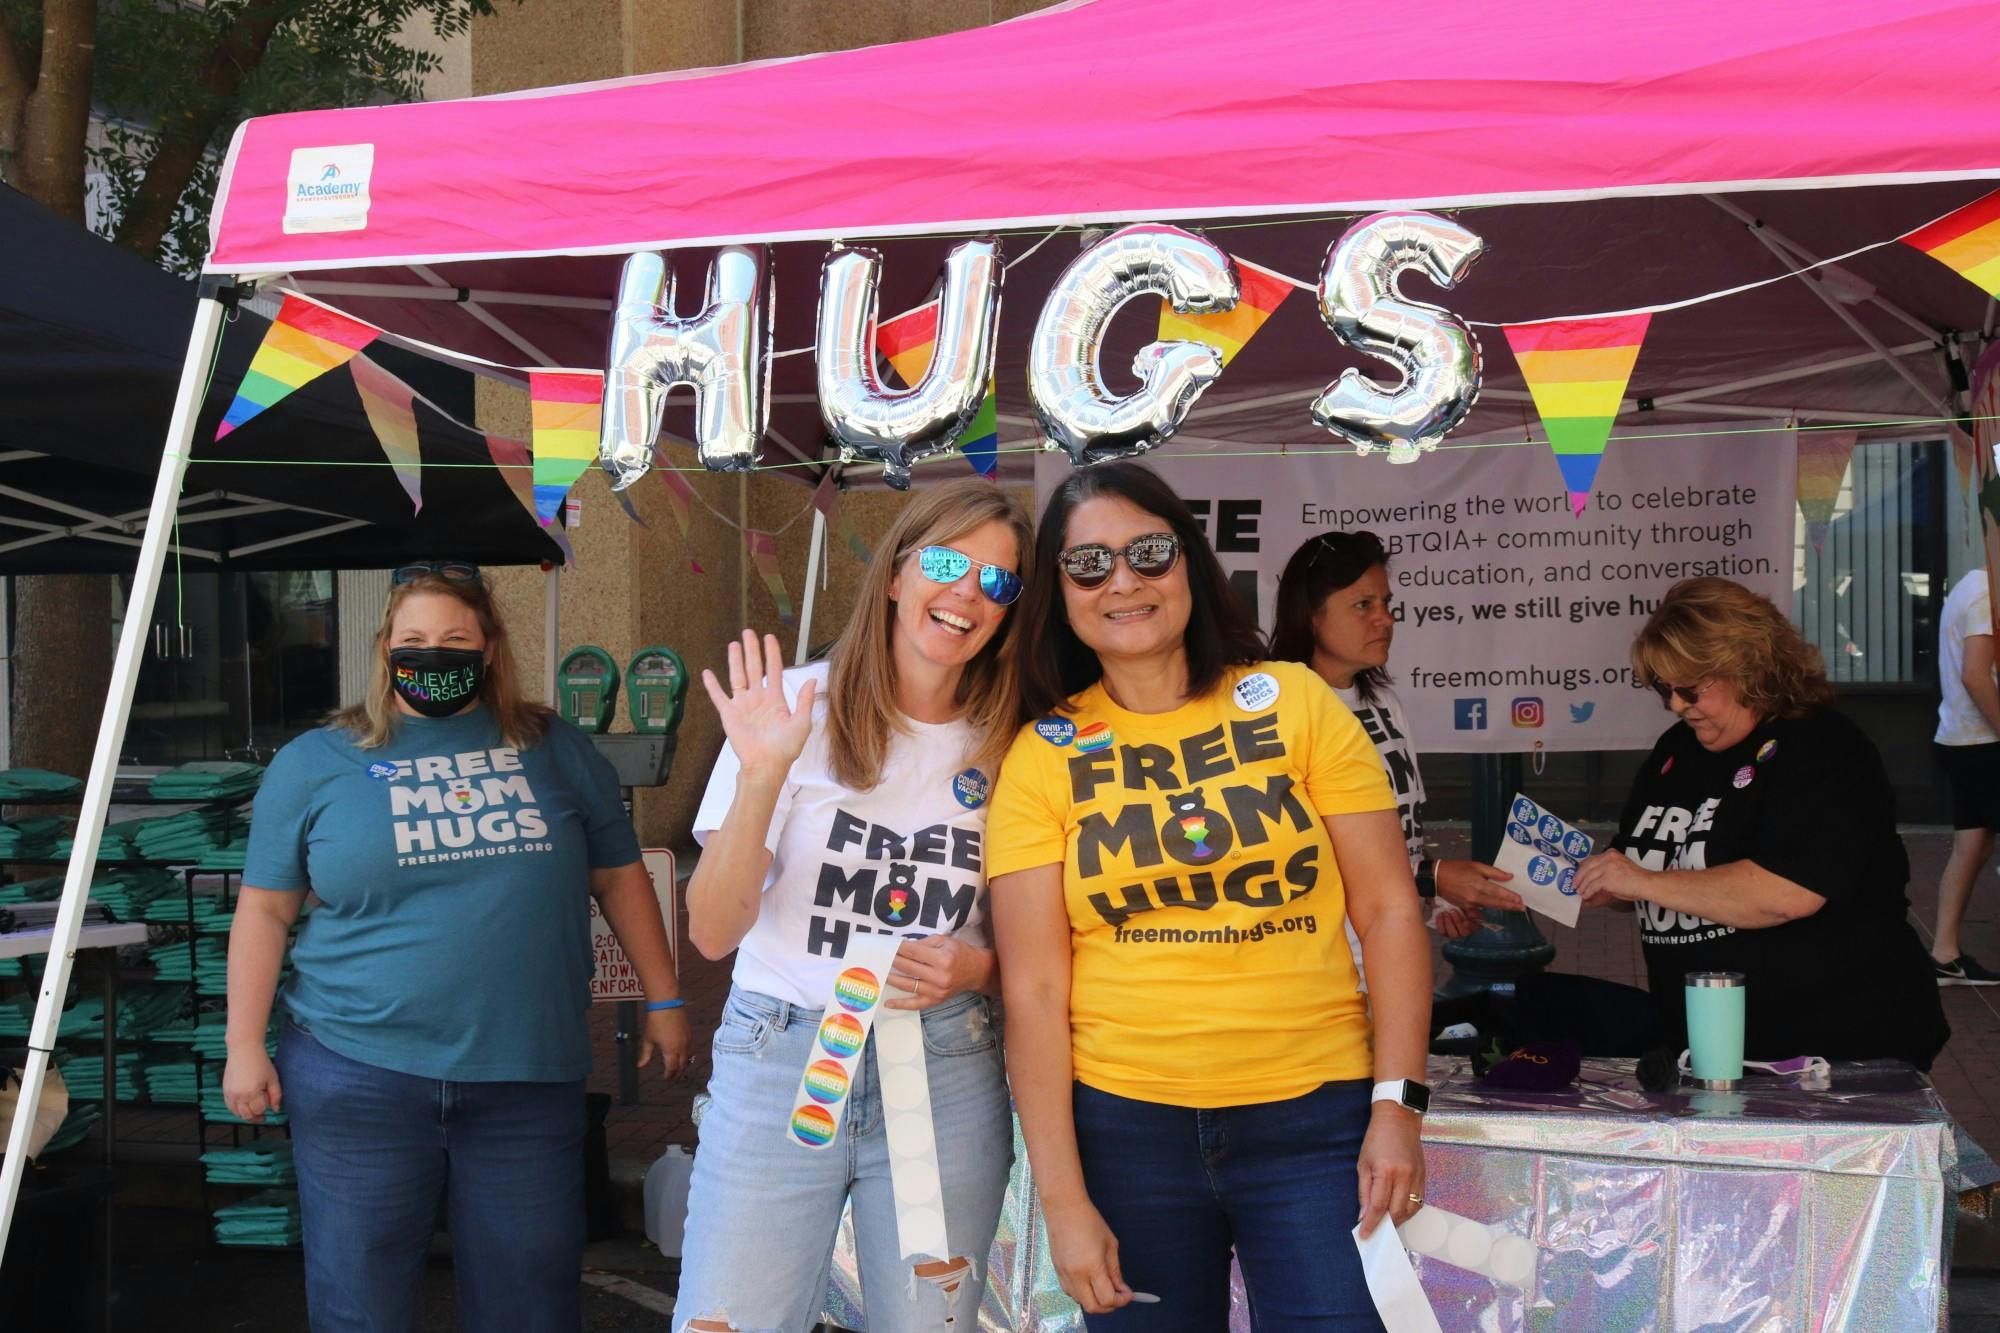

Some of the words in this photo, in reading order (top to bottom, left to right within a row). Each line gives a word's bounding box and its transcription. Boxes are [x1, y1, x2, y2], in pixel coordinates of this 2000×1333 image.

[297, 182, 360, 197] Academy
[600, 209, 1484, 490] HUGS
[1302, 501, 1457, 530] Empowering
[1466, 496, 1505, 515] the
[1514, 490, 1587, 514] worl
[1596, 491, 1622, 511] to
[1632, 484, 1756, 509] celebrate
[1497, 524, 1642, 550] community
[1651, 518, 1753, 546] through
[1398, 563, 1534, 587] education,
[1544, 560, 1591, 582] and
[1601, 554, 1779, 581] conversation.
[1413, 604, 1464, 627] yes,
[1471, 603, 1507, 620] we
[1514, 597, 1562, 619] still
[1569, 596, 1620, 623] give
[1629, 594, 1662, 616] hu
[397, 677, 475, 702] YOURSELF
[1236, 674, 1264, 692] FREE
[1241, 681, 1269, 699] MOM
[1411, 665, 1642, 691] freemomhugs.org
[1246, 688, 1273, 706] HUGS
[1038, 723, 1073, 732] COVID-19
[1078, 730, 1111, 746] HUGGED
[387, 748, 524, 782] FREE
[1068, 712, 1286, 804] FREE
[390, 775, 537, 816] MOM
[958, 774, 989, 794] COVID-19
[394, 808, 548, 854] HUGS
[1077, 773, 1313, 879] MOM
[826, 808, 981, 873] FREE
[398, 842, 553, 867] FREEMOMHUGS.ORG
[814, 862, 976, 932] MOM
[1088, 845, 1319, 927] HUGS
[595, 934, 615, 948] 2:0
[592, 949, 625, 962] SATU
[592, 980, 645, 993] ENFORC
[839, 981, 874, 1000] HUGGED
[825, 1026, 859, 1046] HUGGED
[809, 1070, 845, 1093] HUGGED
